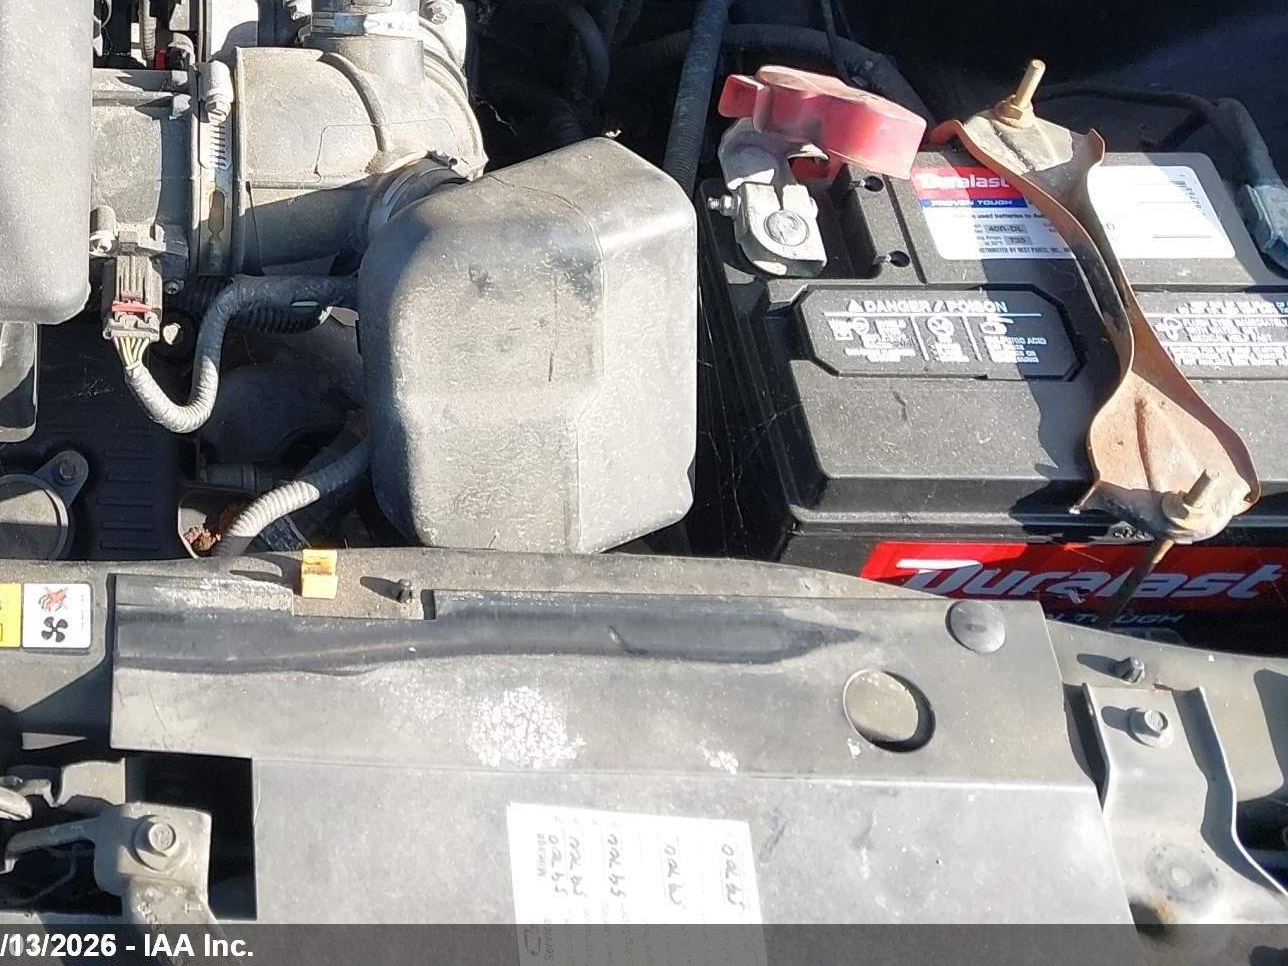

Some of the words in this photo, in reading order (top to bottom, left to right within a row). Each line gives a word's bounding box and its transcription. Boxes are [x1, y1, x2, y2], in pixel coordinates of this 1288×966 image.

[863, 300, 930, 313] DANGER
[945, 301, 1008, 313] POISON
[896, 559, 1284, 598] Duralast
[1074, 613, 1185, 624] TUGH
[537, 833, 548, 877] Mileage
